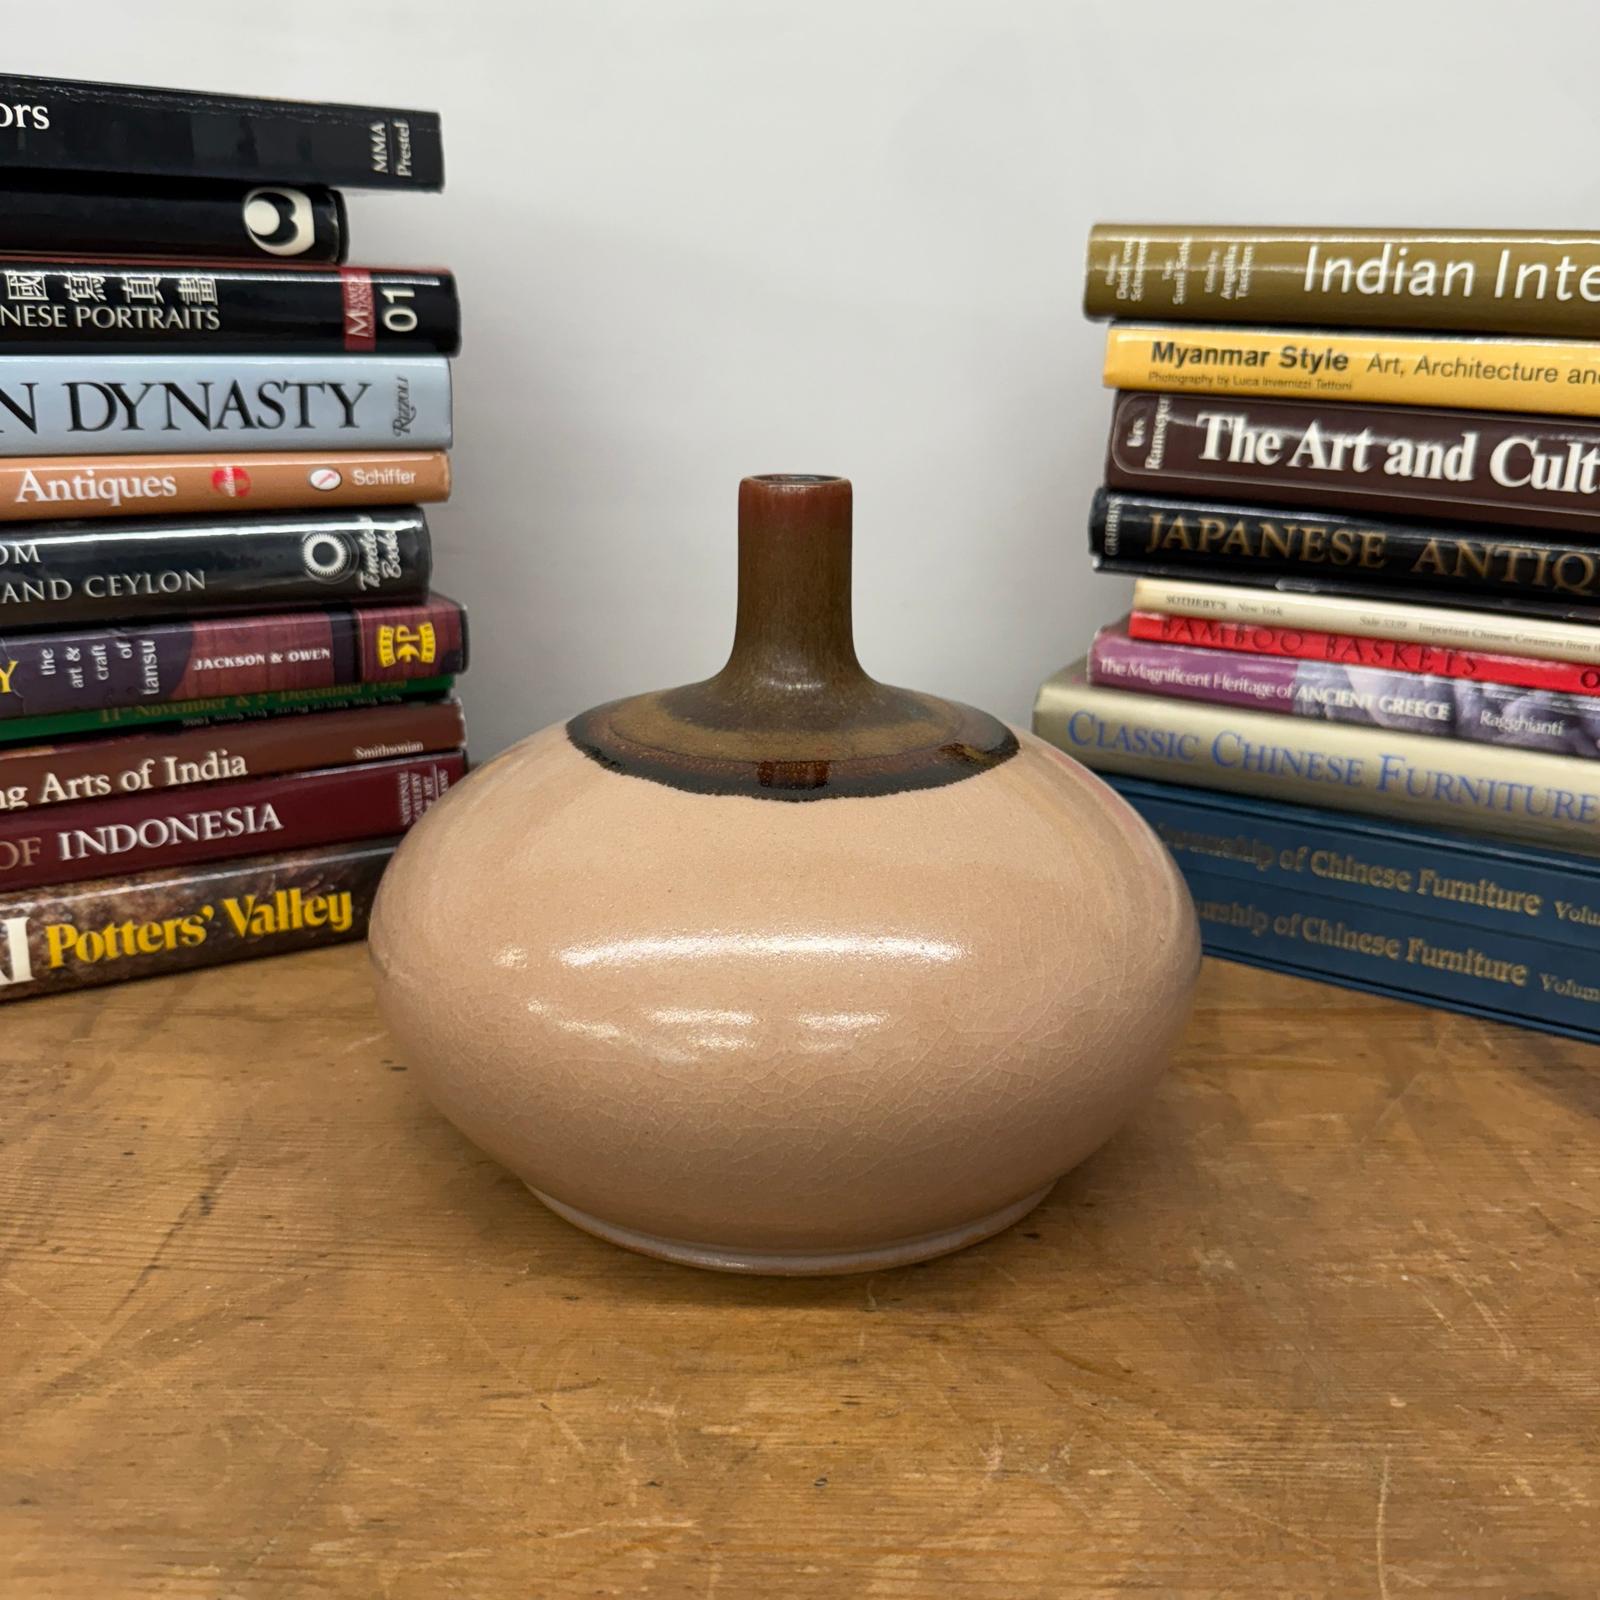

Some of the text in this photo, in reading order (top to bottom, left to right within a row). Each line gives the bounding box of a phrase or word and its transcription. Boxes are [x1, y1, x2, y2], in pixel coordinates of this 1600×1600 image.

[369, 121, 388, 173] MMA
[392, 119, 412, 176] Prestel
[1303, 244, 1600, 302] Indian Inte
[0, 304, 220, 330] NESE PORTRAITS
[1151, 341, 1271, 369] Myanmar
[1278, 345, 1350, 375] Style
[1366, 357, 1407, 378] Art,
[1414, 356, 1560, 384] Architecture
[62, 378, 374, 433] DYNASTY
[1195, 412, 1285, 466] The
[1286, 419, 1376, 473] Art
[1383, 431, 1481, 482] and
[15, 470, 176, 507] Antiques
[352, 468, 416, 487] Schiffer
[1145, 512, 1388, 569] JAPANESE
[2, 569, 206, 604] AND CEYLON
[41, 648, 56, 676] the
[66, 646, 84, 689] art &
[91, 644, 109, 681] craft
[116, 641, 133, 659] of
[139, 640, 160, 696] tansu
[193, 648, 331, 671] JACKSON & OWEN
[1161, 614, 1303, 653] BAMBOO
[1324, 634, 1477, 676] BASKETS
[137, 697, 226, 716] November
[1100, 657, 1450, 721] The Magnificent Heritage of ANCIENT GREECE
[354, 741, 424, 759] Smithsonian
[1480, 710, 1566, 737] Ragghianti
[39, 771, 112, 805] Arts
[120, 759, 156, 793] of
[163, 749, 248, 786] India
[1067, 710, 1600, 825] CLASSIC CHINESE FURNITURE
[0, 803, 284, 870] OF INDONESIA
[1279, 846, 1310, 872] of
[1310, 850, 1413, 893] Chinese
[1417, 868, 1543, 917] Furniture
[45, 907, 213, 969] Potters'
[223, 889, 353, 939] Valley
[1273, 912, 1302, 937] of
[1302, 917, 1402, 960] Chinese
[1406, 937, 1529, 988] Furniture
